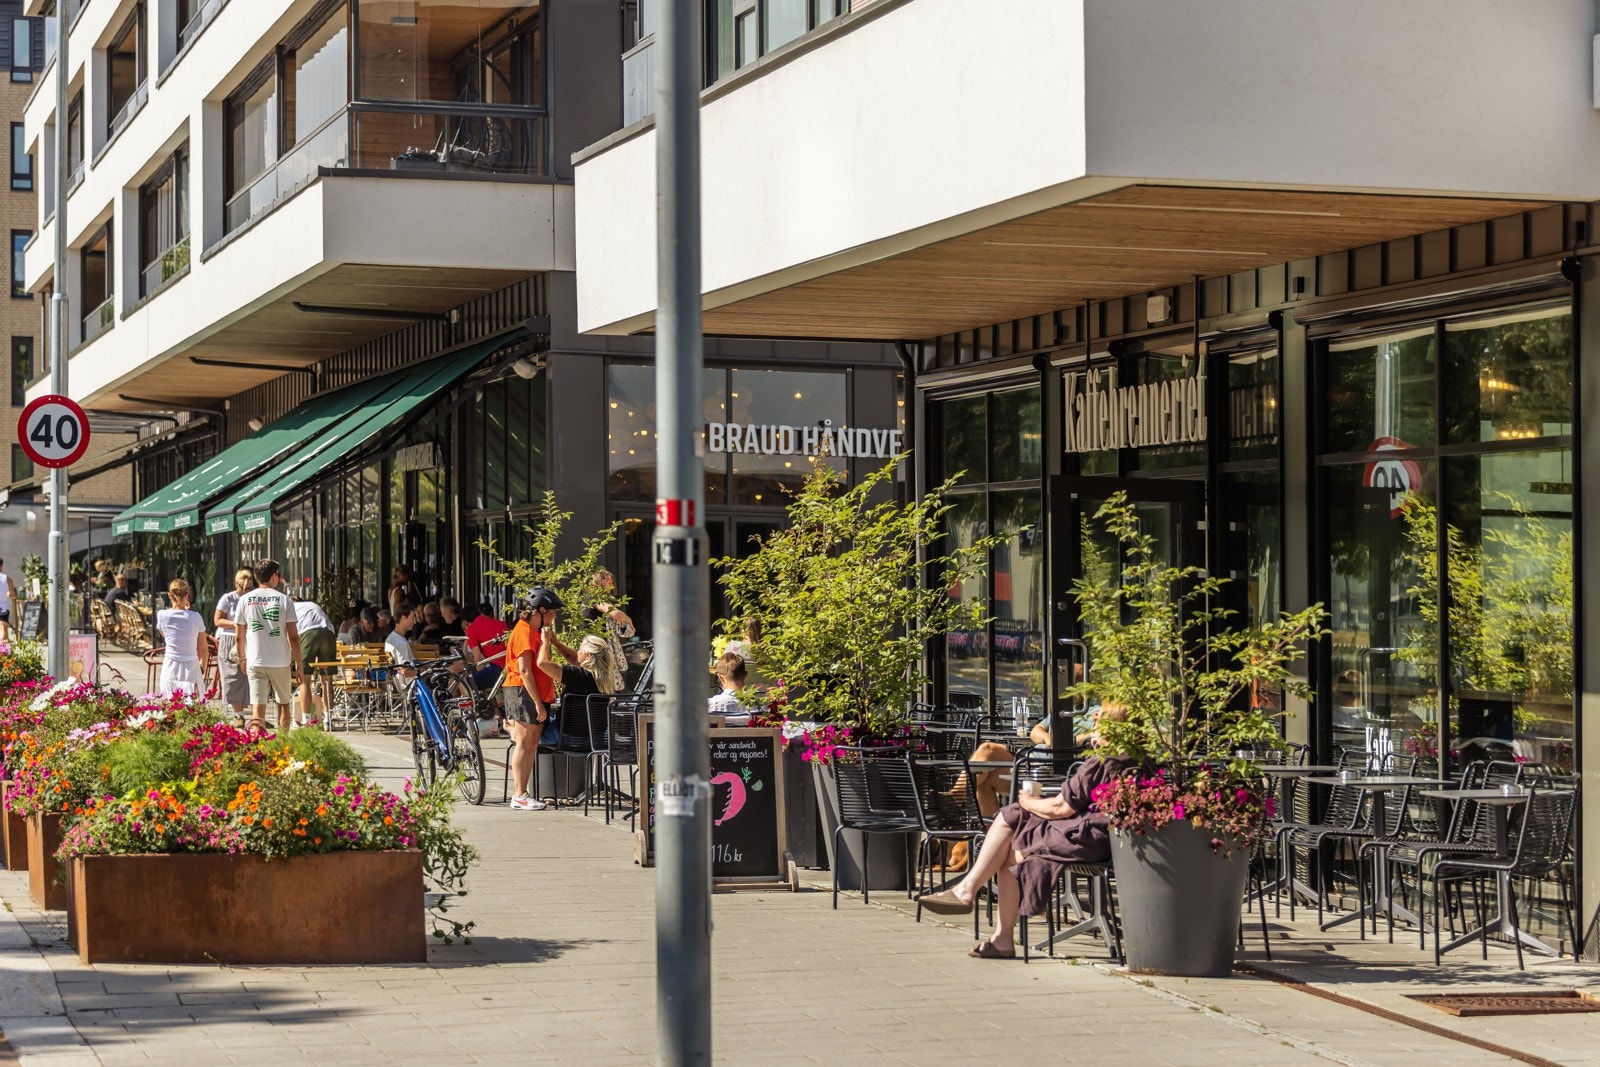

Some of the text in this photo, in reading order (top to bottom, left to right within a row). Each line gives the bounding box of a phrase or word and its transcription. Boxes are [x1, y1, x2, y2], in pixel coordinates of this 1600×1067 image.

[1063, 354, 1208, 453] Kaffebrenneriet
[30, 414, 78, 450] 40
[709, 419, 903, 459] BRAUD HÅNDVE
[729, 741, 757, 749] sandwich
[729, 752, 738, 762] og
[711, 844, 743, 863] 116 kr
